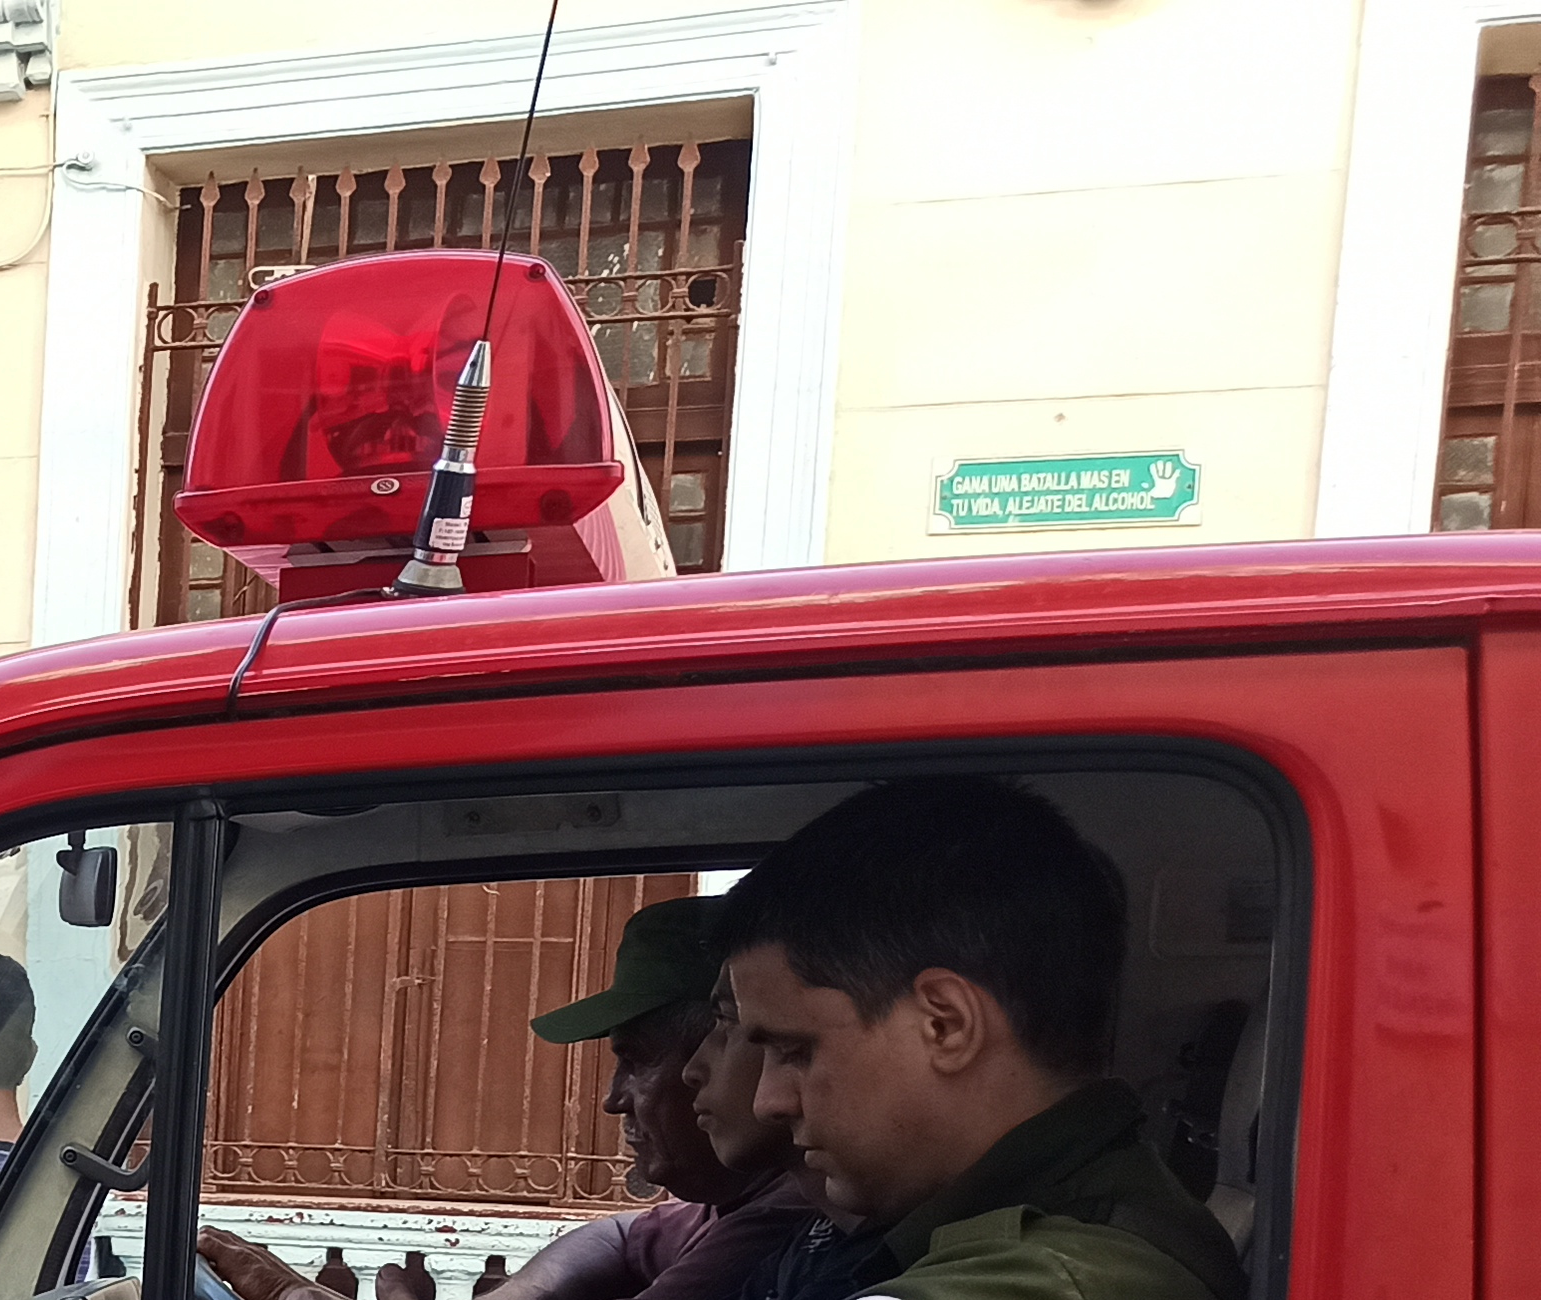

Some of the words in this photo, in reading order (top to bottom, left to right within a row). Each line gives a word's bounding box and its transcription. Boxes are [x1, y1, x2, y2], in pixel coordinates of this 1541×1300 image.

[952, 475, 989, 494] GANA
[991, 474, 1019, 493] UNA
[1020, 471, 1077, 492] BATALLA
[1079, 470, 1109, 489] MAS
[1111, 468, 1131, 488] EN
[951, 498, 969, 517] TU
[1005, 494, 1063, 516] ALEJATE
[1064, 493, 1089, 513] DEL
[1091, 491, 1155, 512] ALCOHOL
